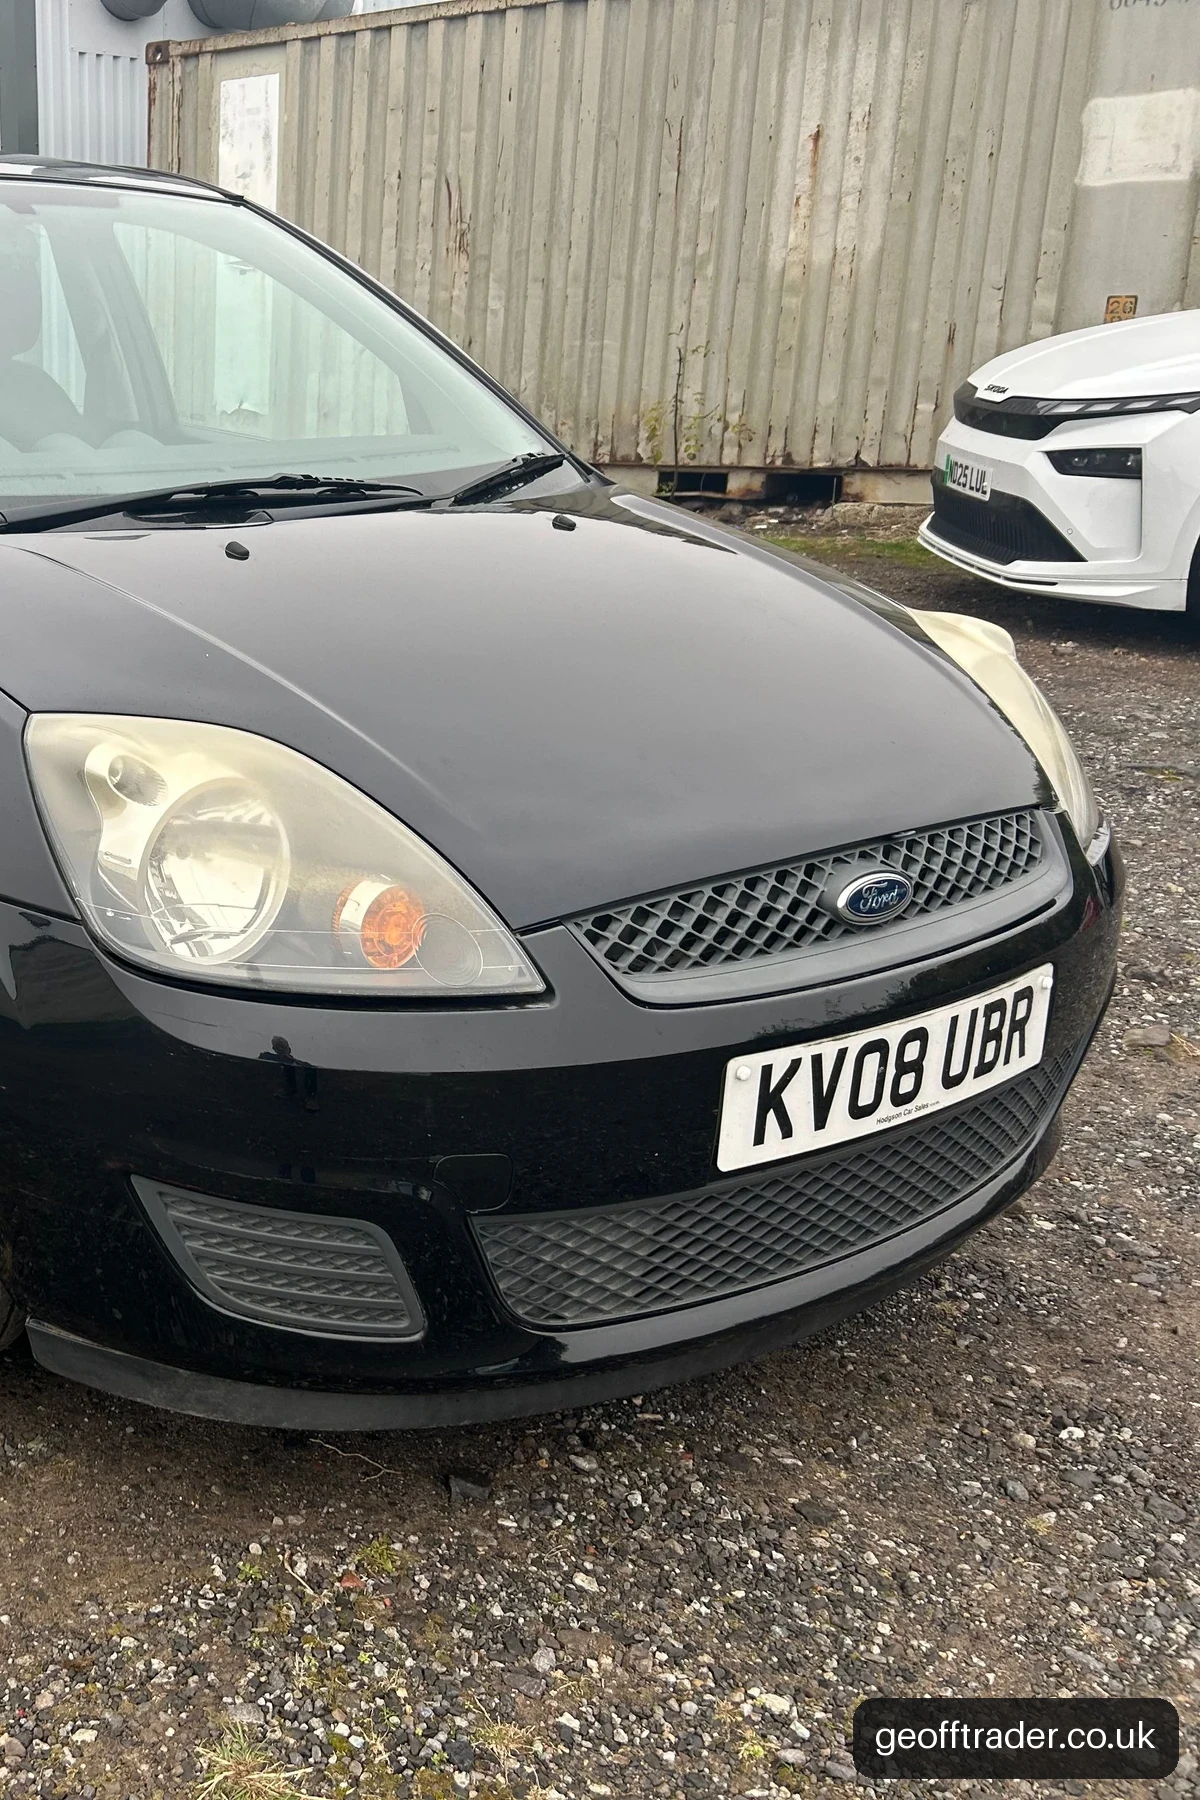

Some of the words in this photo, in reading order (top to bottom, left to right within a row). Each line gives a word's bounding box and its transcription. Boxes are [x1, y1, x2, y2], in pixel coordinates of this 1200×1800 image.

[949, 459, 969, 488] ND25
[860, 882, 899, 912] Ford
[753, 1026, 929, 1146] KV08
[941, 985, 1034, 1091] UBR
[876, 1111, 903, 1125] Hodgson
[903, 1108, 914, 1117] Car
[914, 1102, 929, 1113] Sales
